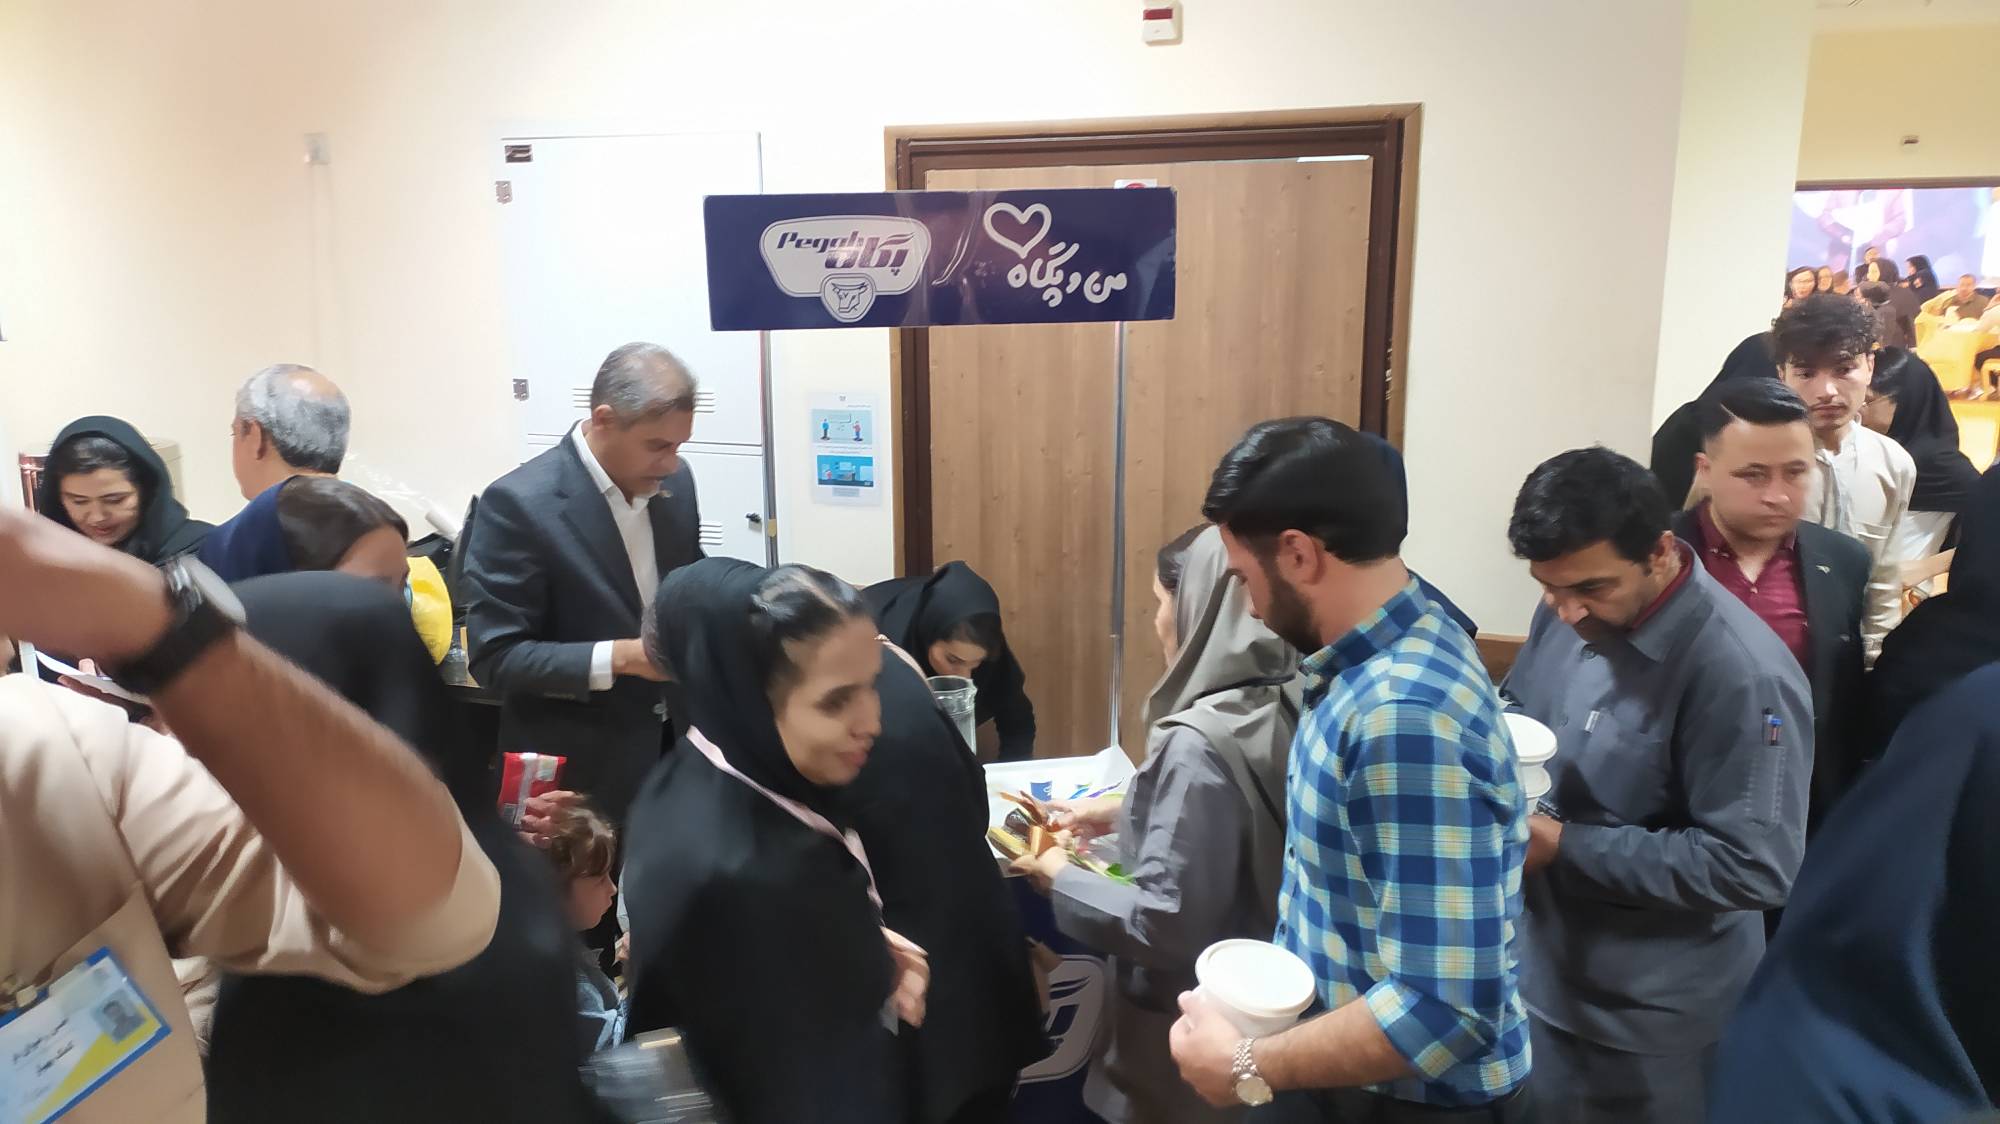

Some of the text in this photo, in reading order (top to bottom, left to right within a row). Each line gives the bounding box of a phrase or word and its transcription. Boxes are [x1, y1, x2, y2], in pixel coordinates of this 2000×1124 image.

[777, 231, 864, 253] Pegah
[825, 231, 915, 276] پگاه
[1007, 241, 1128, 307] من و پگاه
